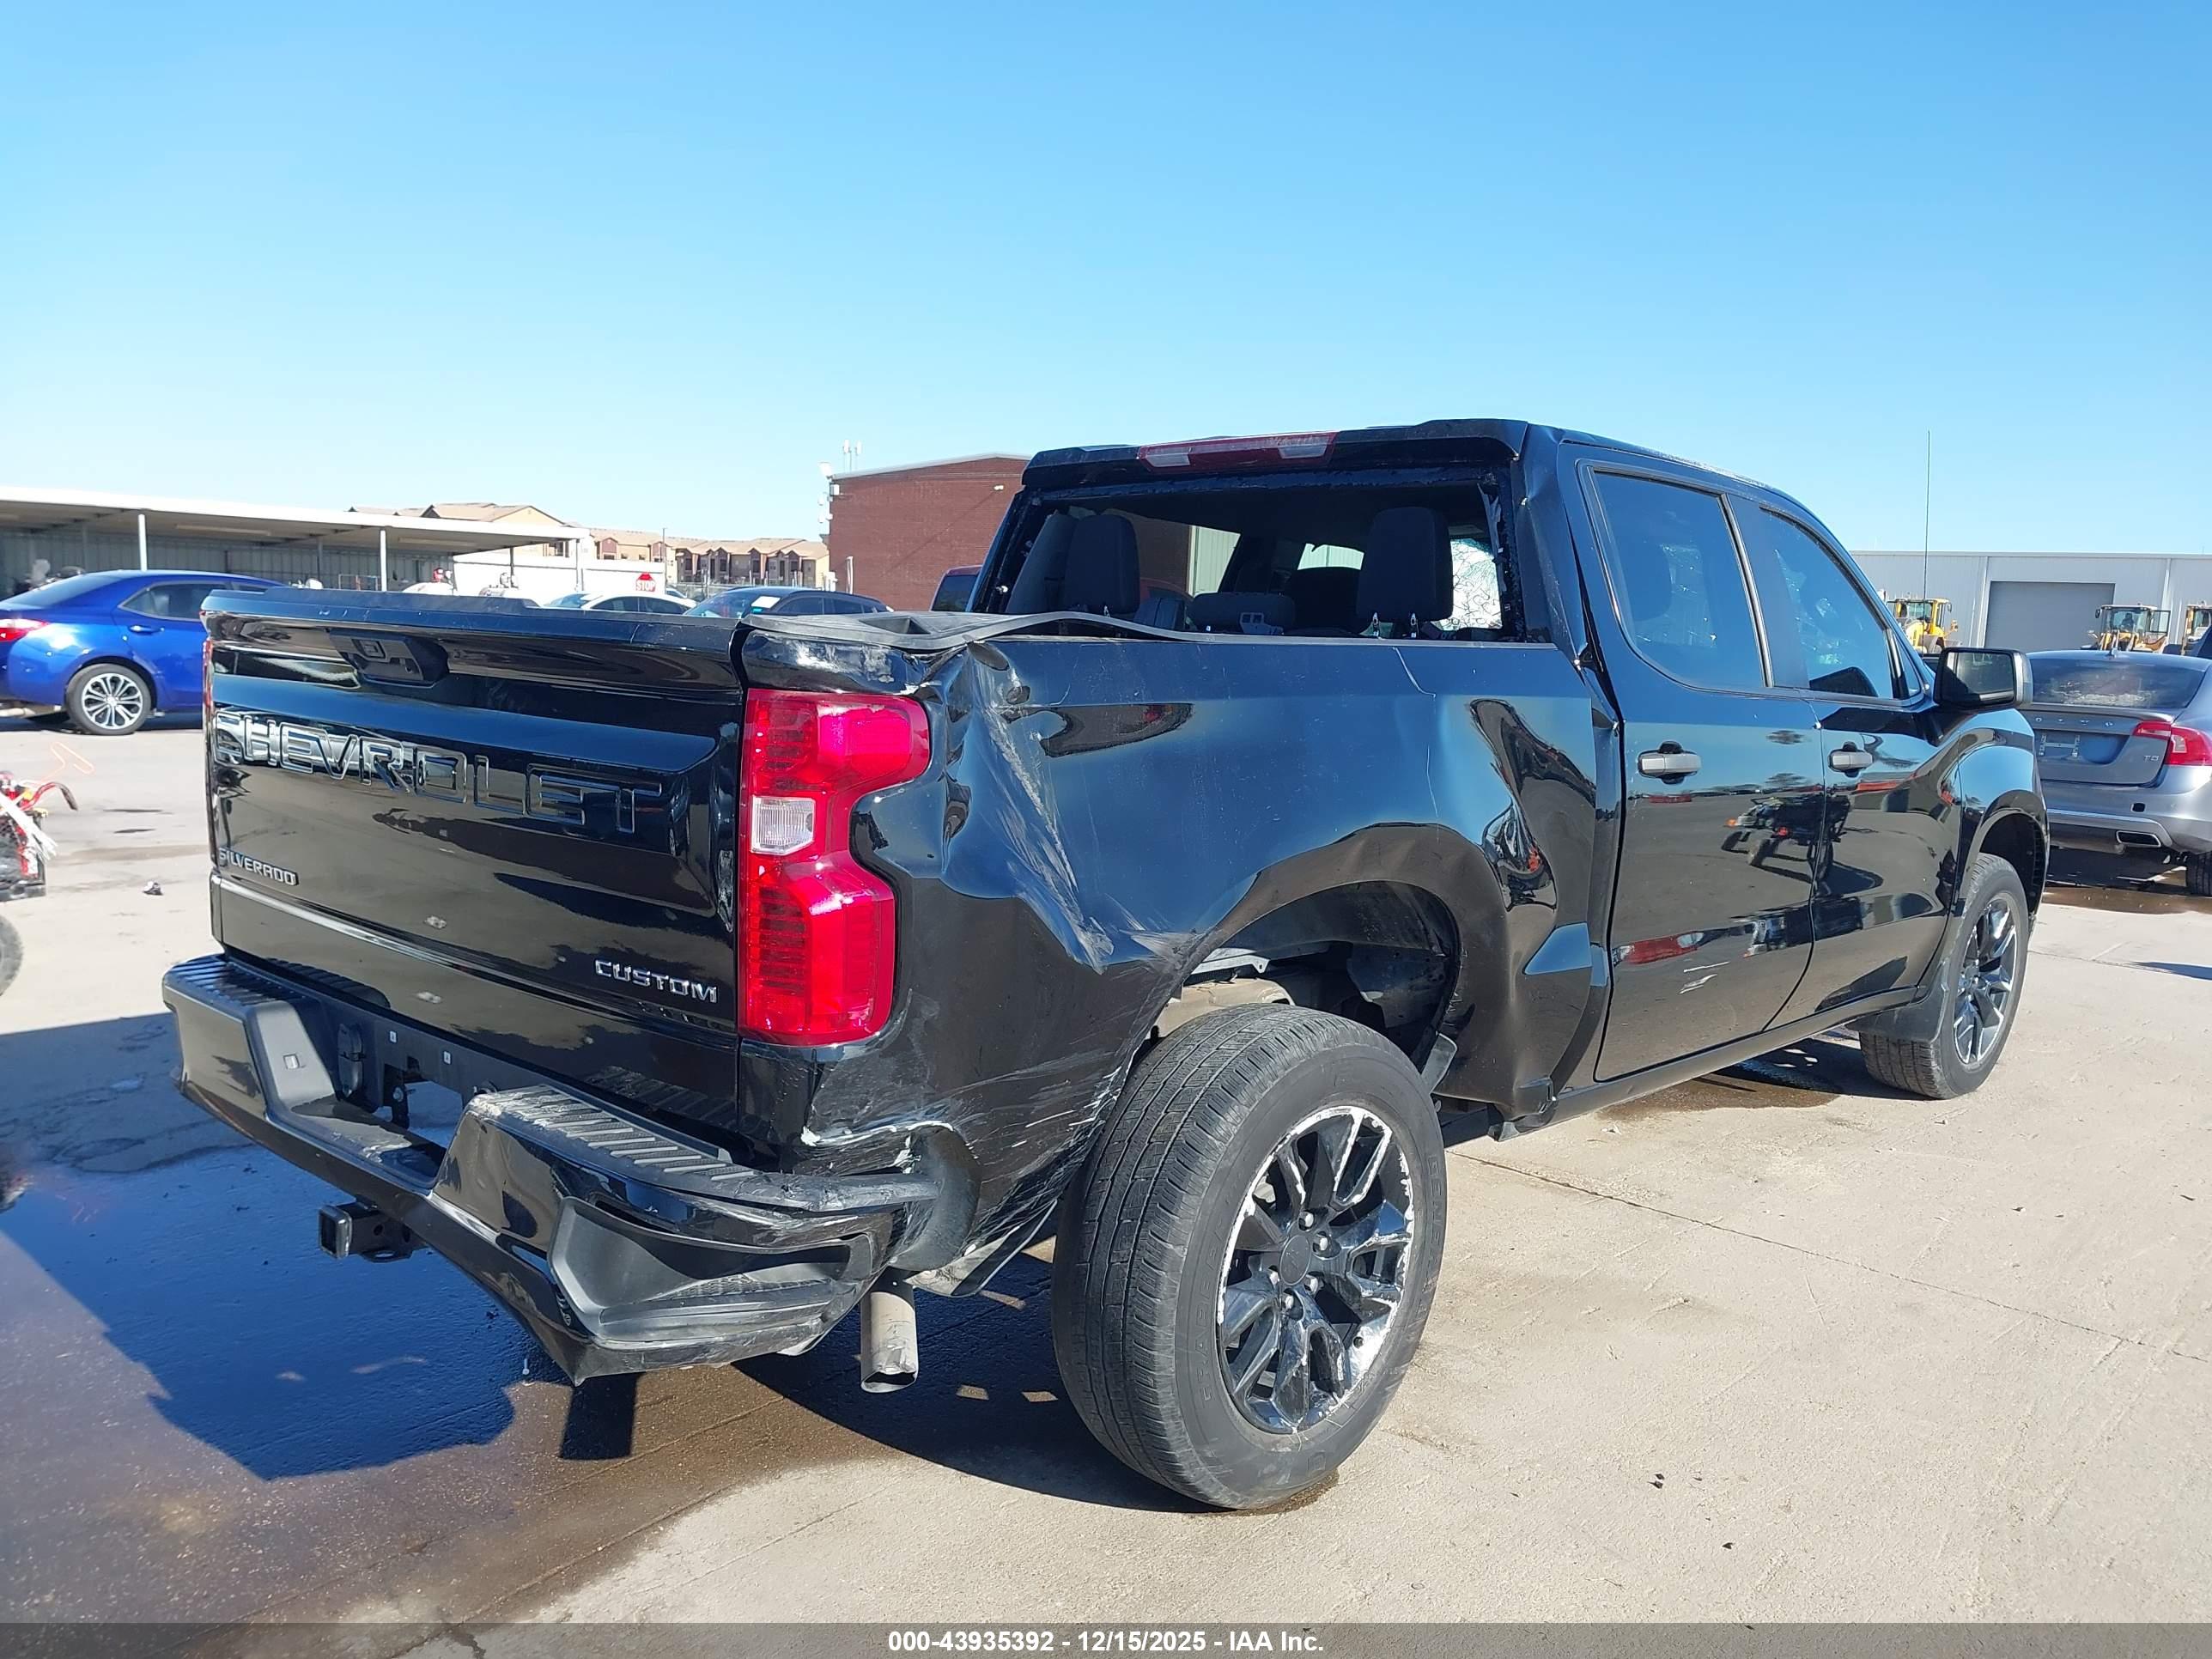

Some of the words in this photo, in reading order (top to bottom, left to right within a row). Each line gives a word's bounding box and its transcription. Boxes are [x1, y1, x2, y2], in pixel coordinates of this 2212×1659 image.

[635, 580, 657, 592] STOP
[213, 711, 663, 834] CHEVROLET
[218, 846, 299, 885] SILVERADO
[594, 959, 718, 1003] CUSTOM
